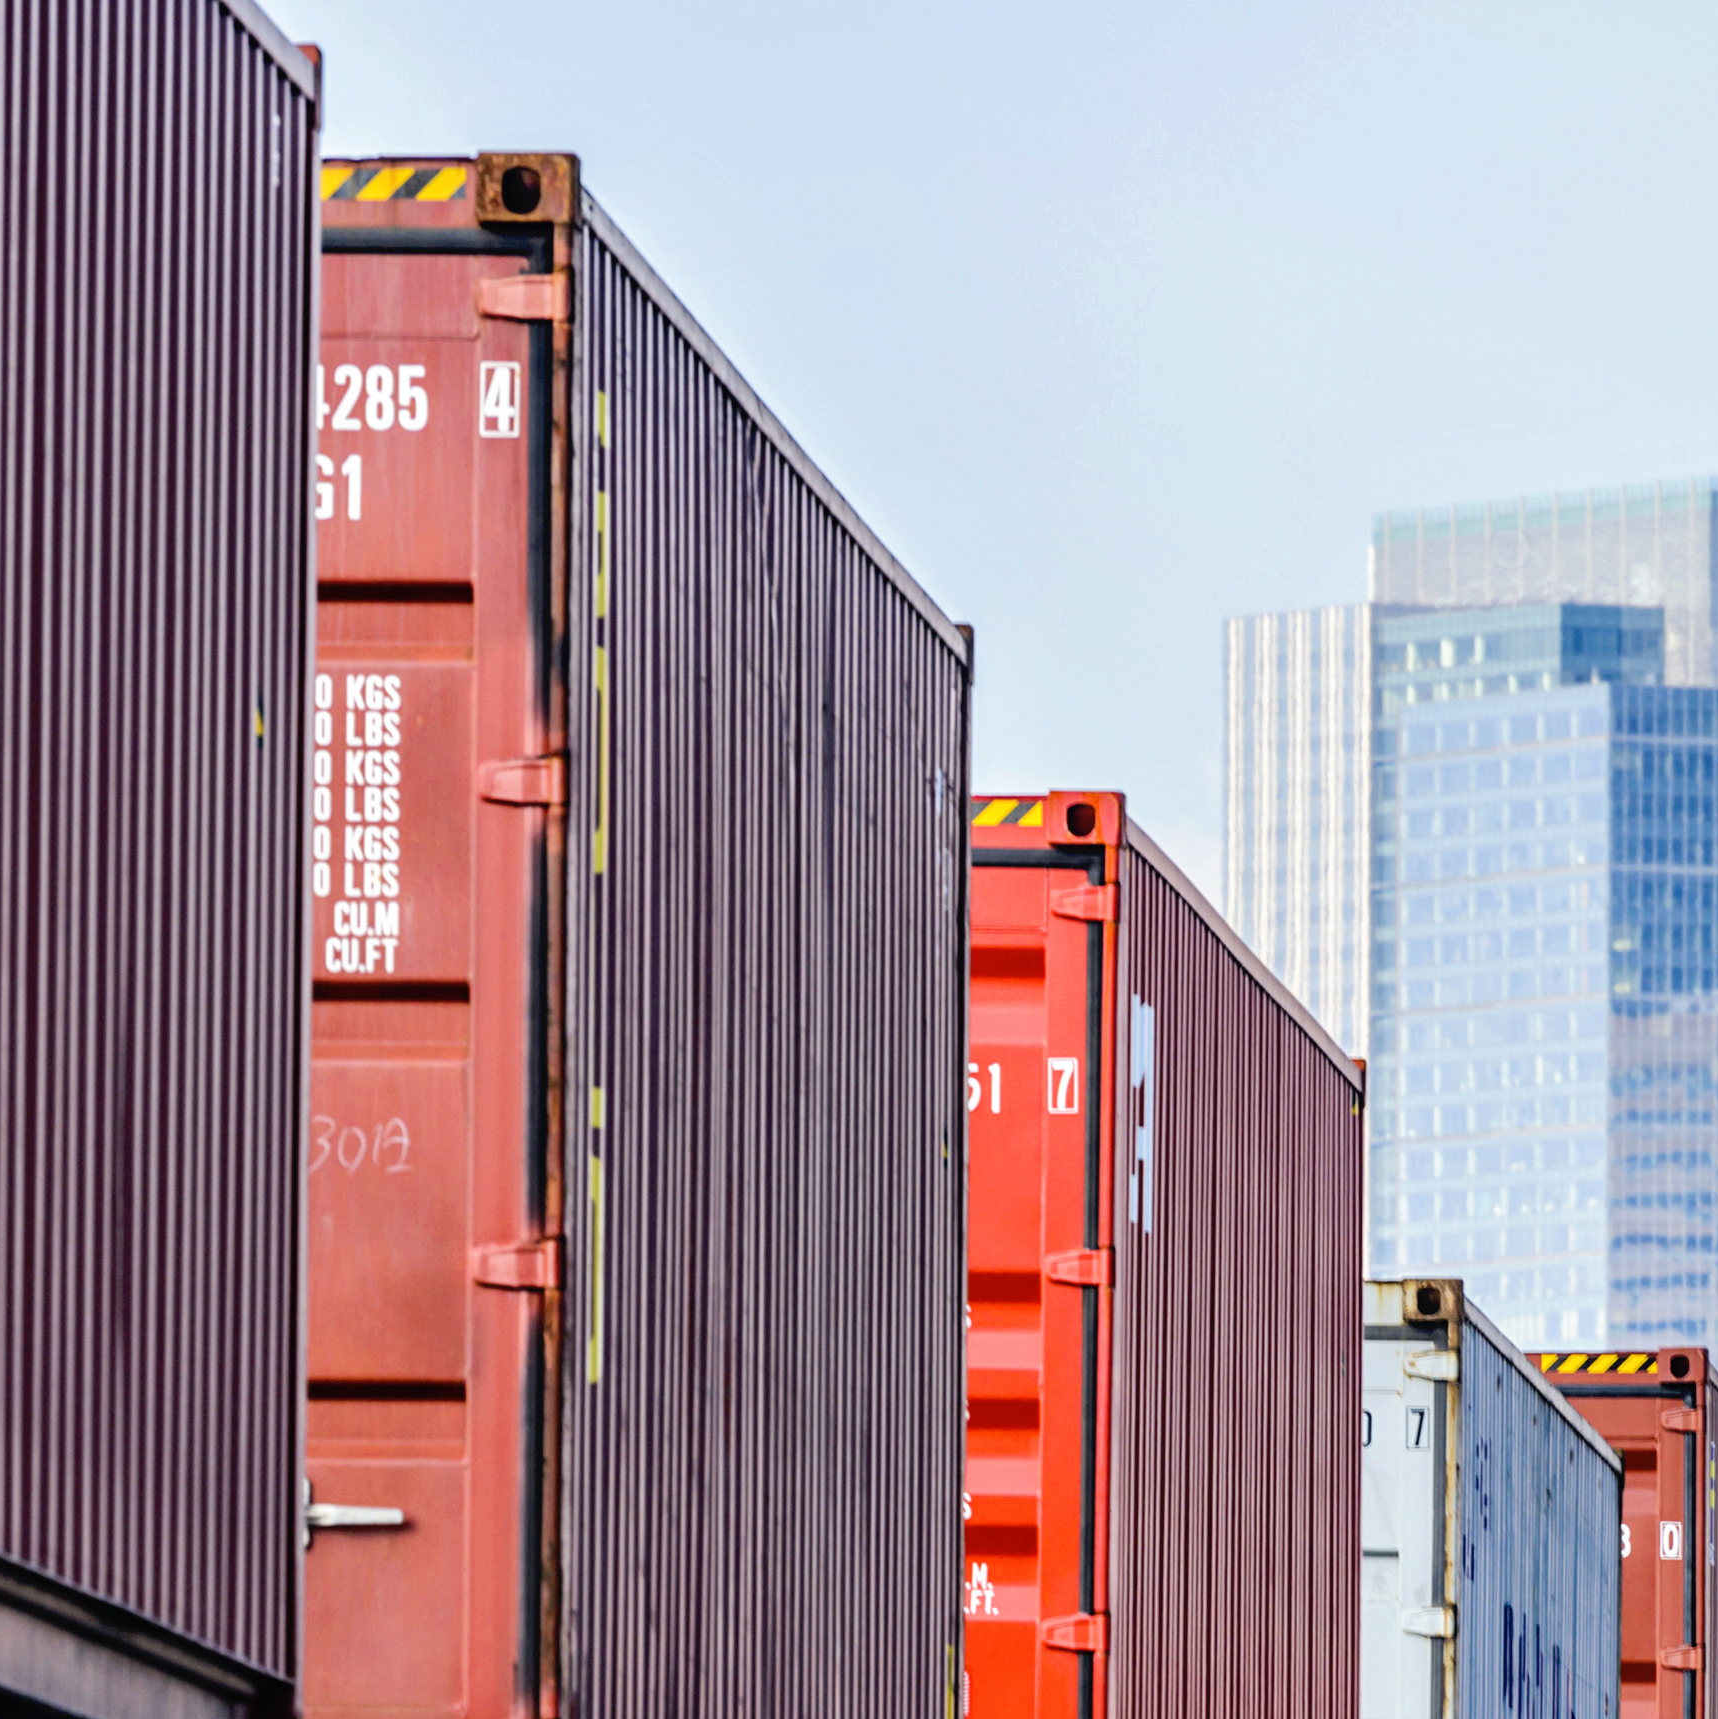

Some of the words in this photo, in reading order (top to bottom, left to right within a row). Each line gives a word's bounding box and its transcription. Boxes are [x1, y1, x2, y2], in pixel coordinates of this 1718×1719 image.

[483, 365, 517, 434] 4
[344, 674, 402, 710] KGS
[344, 711, 402, 747] LBS
[344, 749, 402, 785] KGS
[344, 786, 402, 823] LBS
[344, 825, 402, 861] KGS
[344, 862, 402, 898] LBS
[334, 901, 399, 936] CU.M
[326, 936, 398, 973] CU.FT
[1051, 1061, 1075, 1112] 7
[1409, 1407, 1426, 1447] 7
[1663, 1523, 1679, 1558] 0
